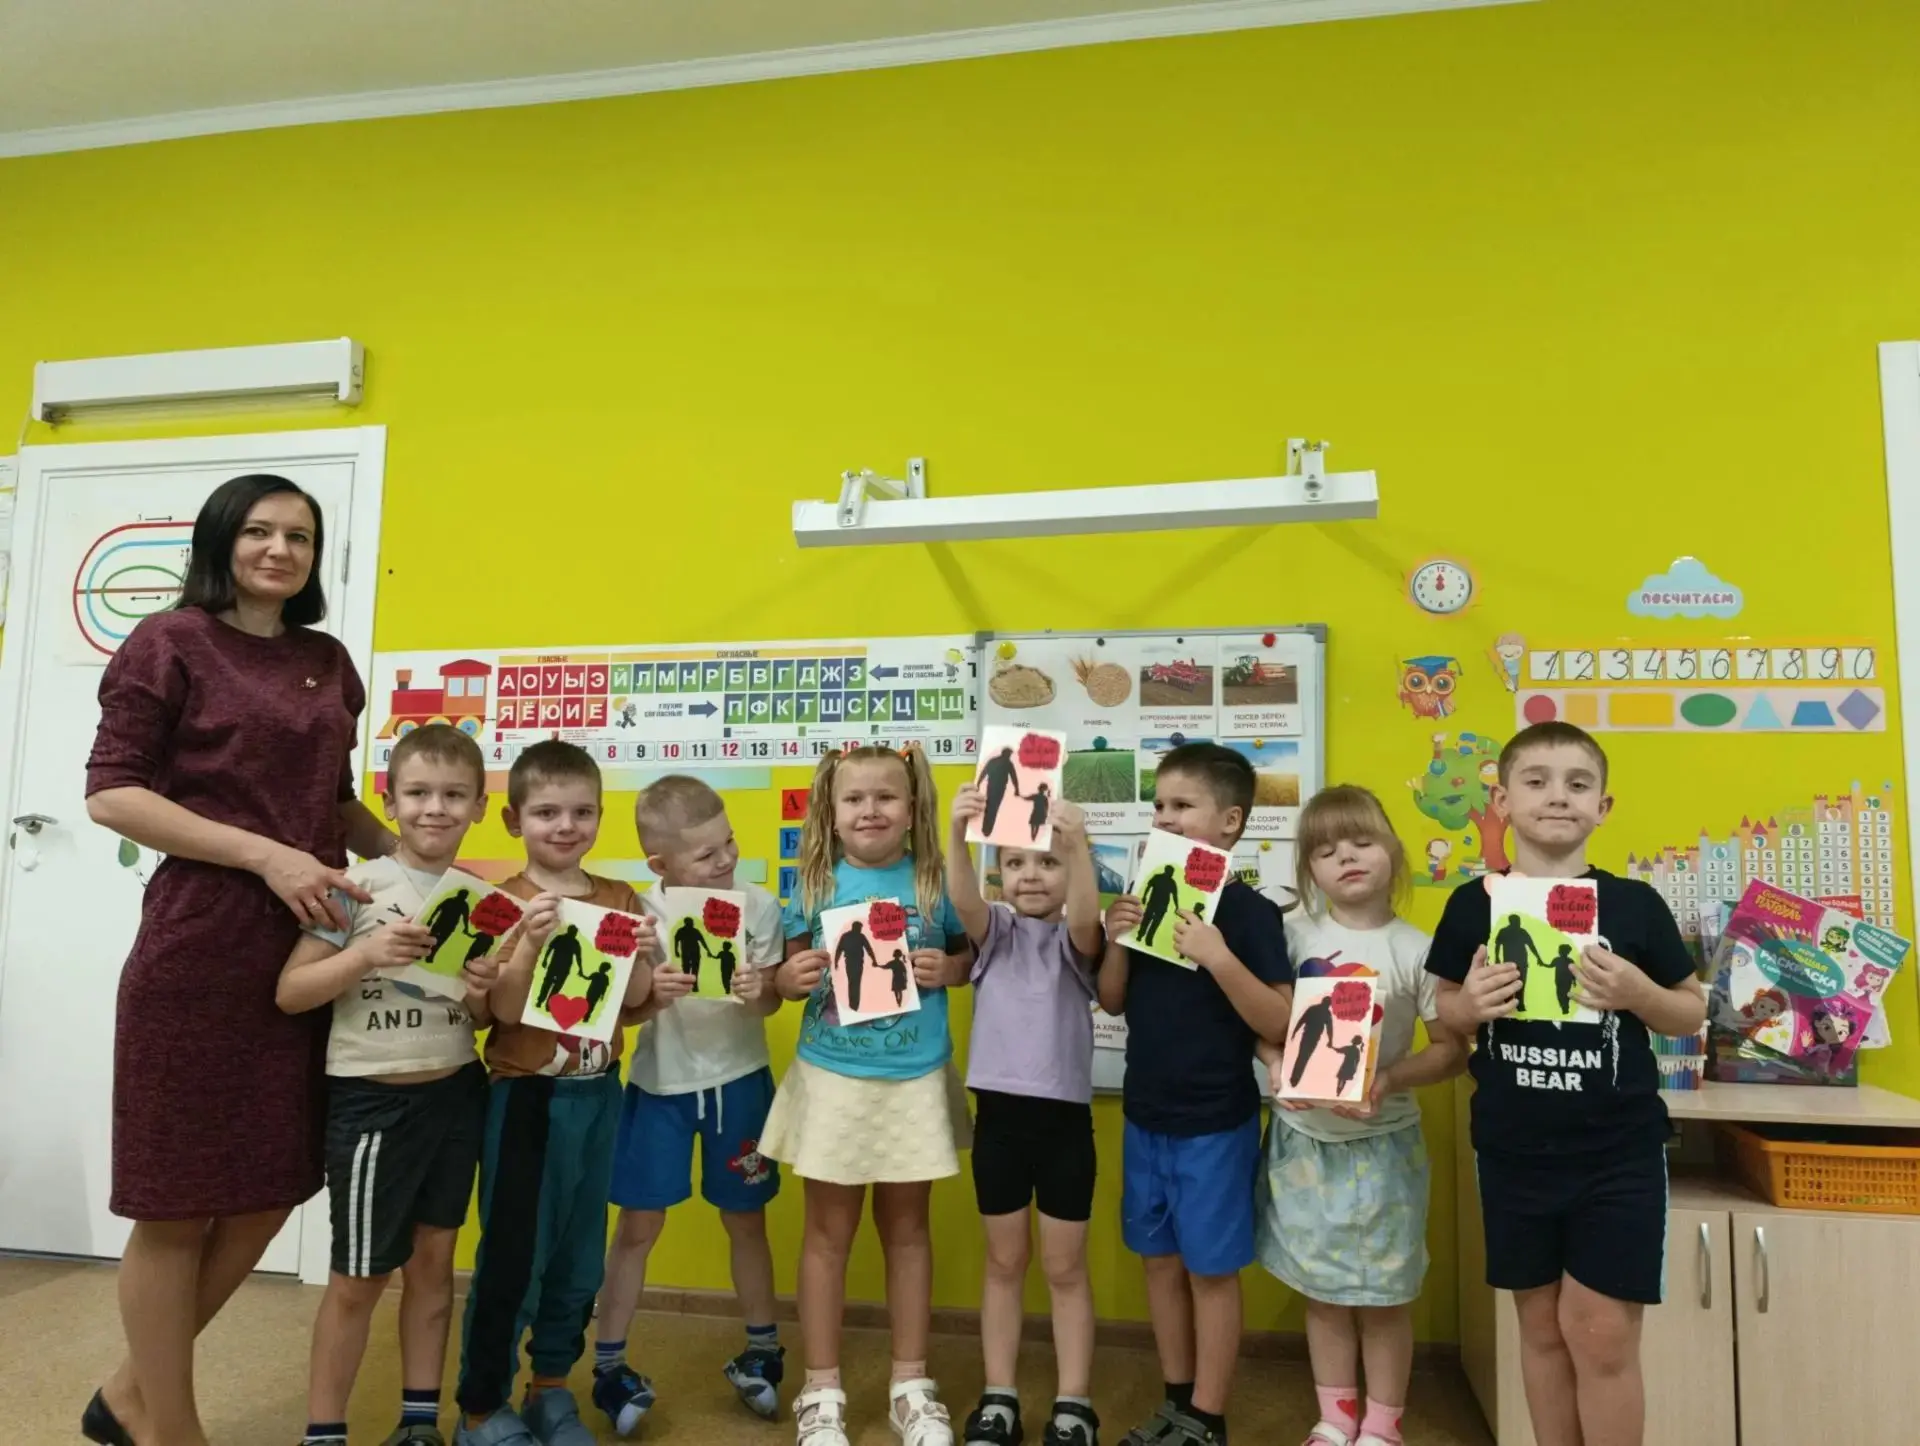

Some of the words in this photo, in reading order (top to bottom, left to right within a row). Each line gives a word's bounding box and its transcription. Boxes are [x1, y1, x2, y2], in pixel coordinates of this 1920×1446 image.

[1641, 593, 1734, 604] ПОСЧИТАЕМ
[1545, 650, 1560, 680] 1
[1575, 651, 1595, 680] 2
[1607, 650, 1630, 680] 3
[1644, 649, 1665, 680] 4
[1675, 649, 1697, 680] 5
[1712, 649, 1733, 680] 6
[1747, 649, 1768, 680] 7
[1783, 648, 1804, 679] 8
[1818, 647, 1840, 679] 9
[1854, 648, 1874, 679] 0
[493, 747, 503, 760] 4
[608, 745, 616, 758] 8
[636, 744, 645, 758] 9
[663, 744, 679, 757] 10
[692, 744, 706, 756] 11
[722, 743, 738, 756] 12
[751, 742, 768, 756] 13
[781, 742, 798, 755] 14
[811, 742, 828, 755] 15
[935, 739, 952, 752] 19
[784, 793, 800, 811] А
[367, 1008, 422, 1031] AND
[1500, 1043, 1601, 1068] RUSSIAN
[1516, 1067, 1583, 1091] BEAR
